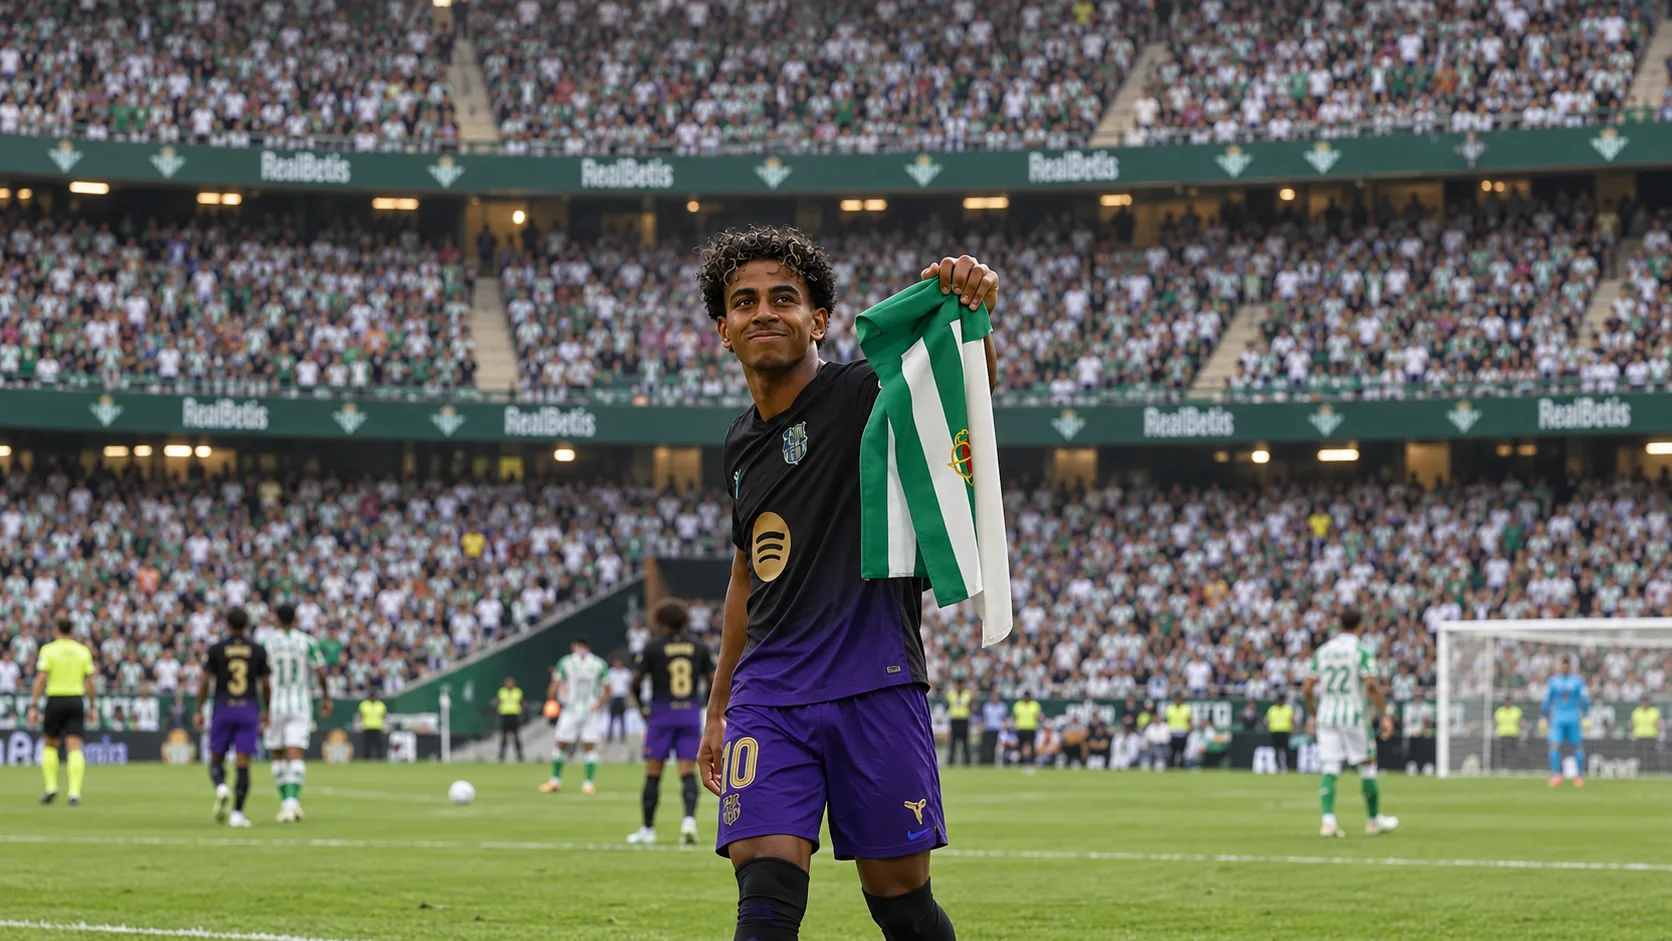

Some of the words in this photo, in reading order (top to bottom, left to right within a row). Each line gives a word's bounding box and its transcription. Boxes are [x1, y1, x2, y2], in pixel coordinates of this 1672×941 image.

[260, 151, 351, 184] RealBetis
[581, 157, 675, 189] RealBetis
[1028, 150, 1119, 183] RealBetis
[182, 396, 269, 430] RealBetis
[503, 405, 596, 438] RealBetis
[1143, 406, 1235, 438] RealBetis
[1537, 396, 1632, 429] RealBetis
[227, 658, 249, 697] 3
[669, 657, 693, 698] 8
[1324, 664, 1352, 695] 22
[721, 736, 759, 795] 10
